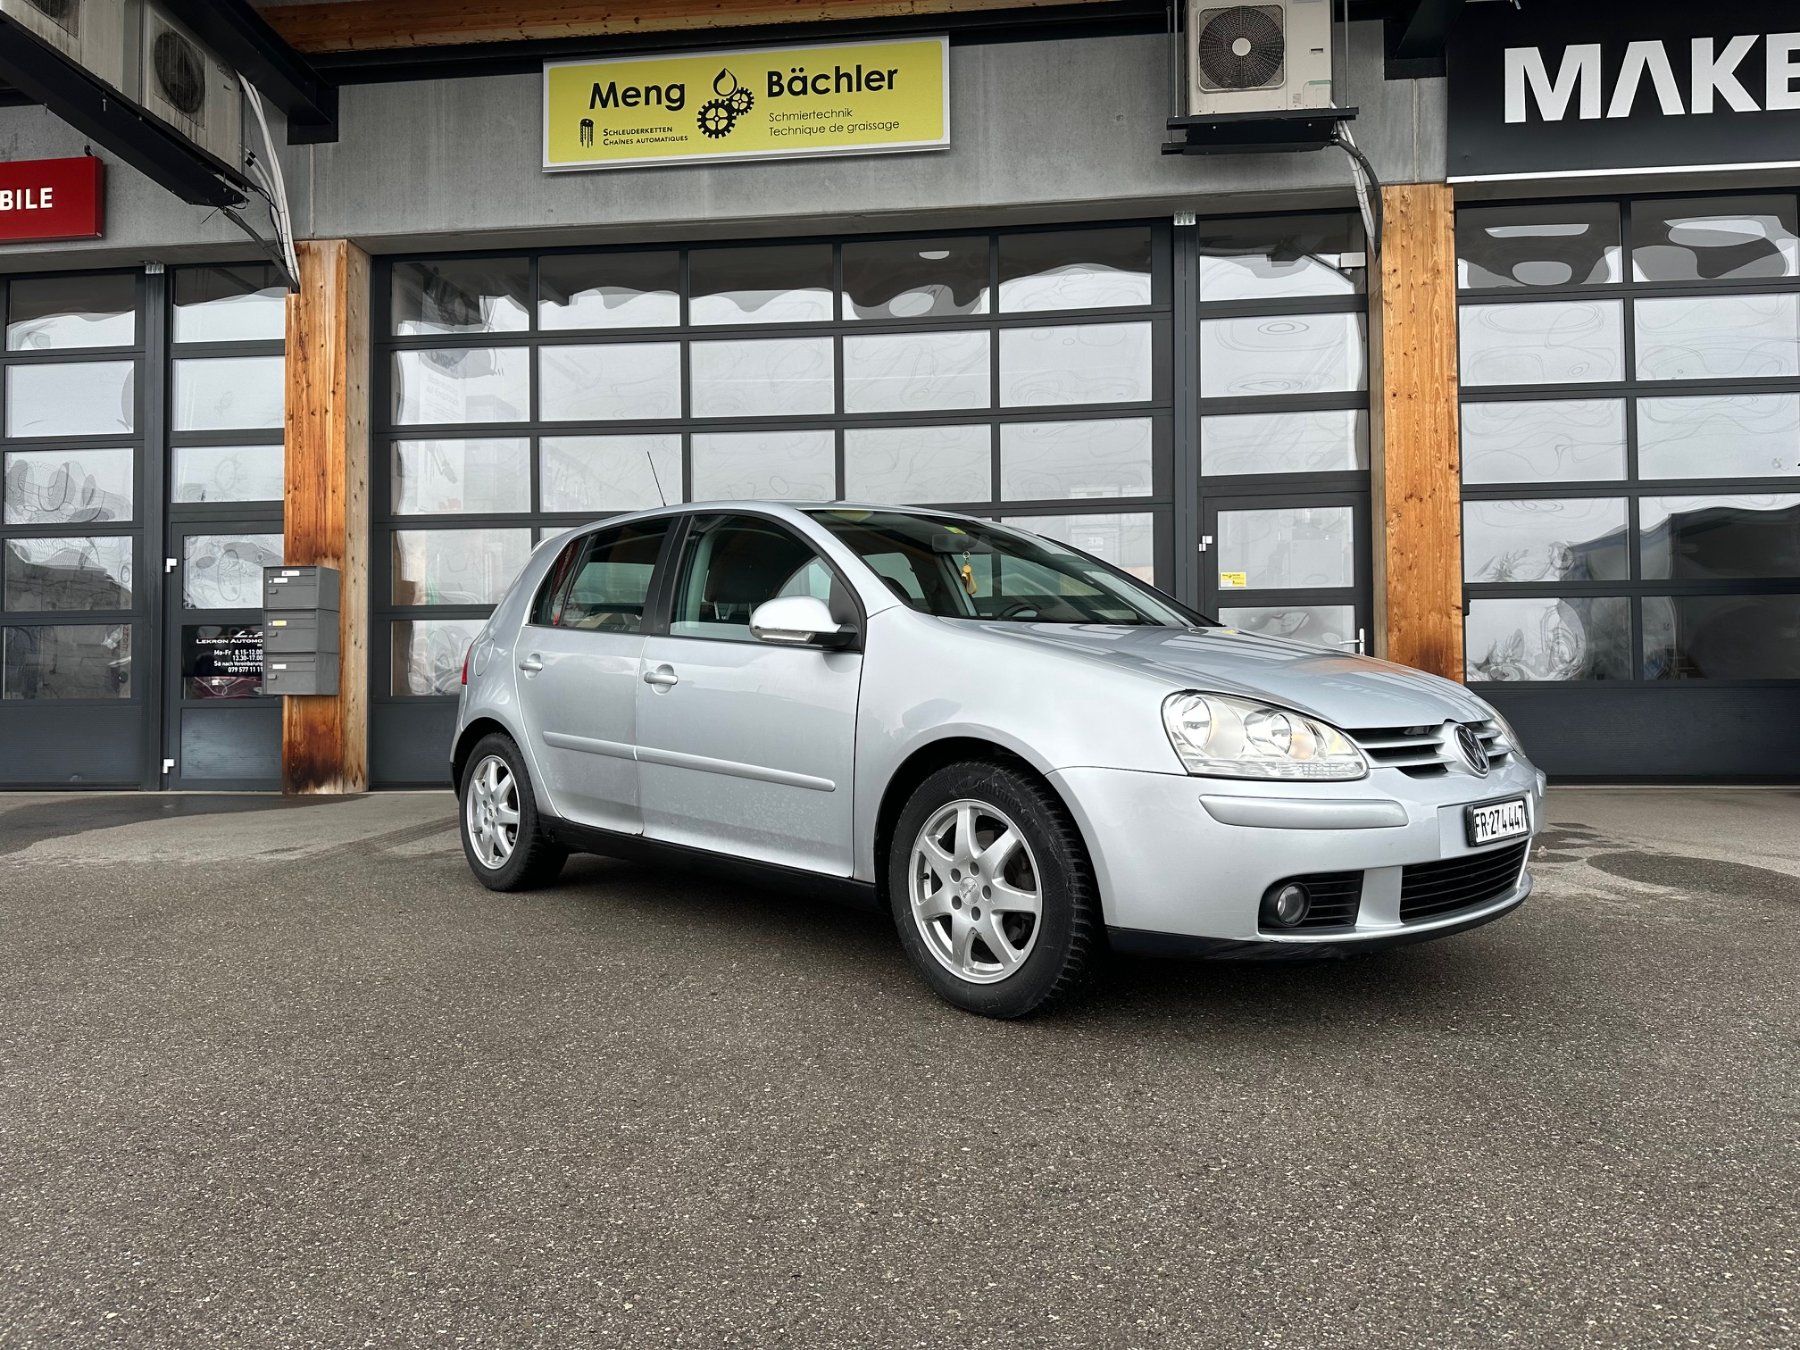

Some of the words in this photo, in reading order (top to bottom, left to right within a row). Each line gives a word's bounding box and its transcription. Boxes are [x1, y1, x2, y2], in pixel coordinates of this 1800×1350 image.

[767, 64, 898, 98] Bächler
[1505, 32, 1800, 123] MAKE
[589, 81, 685, 111] Meng
[769, 108, 853, 122] Schmiertechnik
[603, 126, 672, 137] SCHLEUDERKETTEN
[769, 124, 826, 136] Technique
[829, 123, 844, 133] de
[847, 120, 900, 133] graissage
[636, 135, 688, 144] AUTOMATIQUES
[0, 187, 53, 211] BILE
